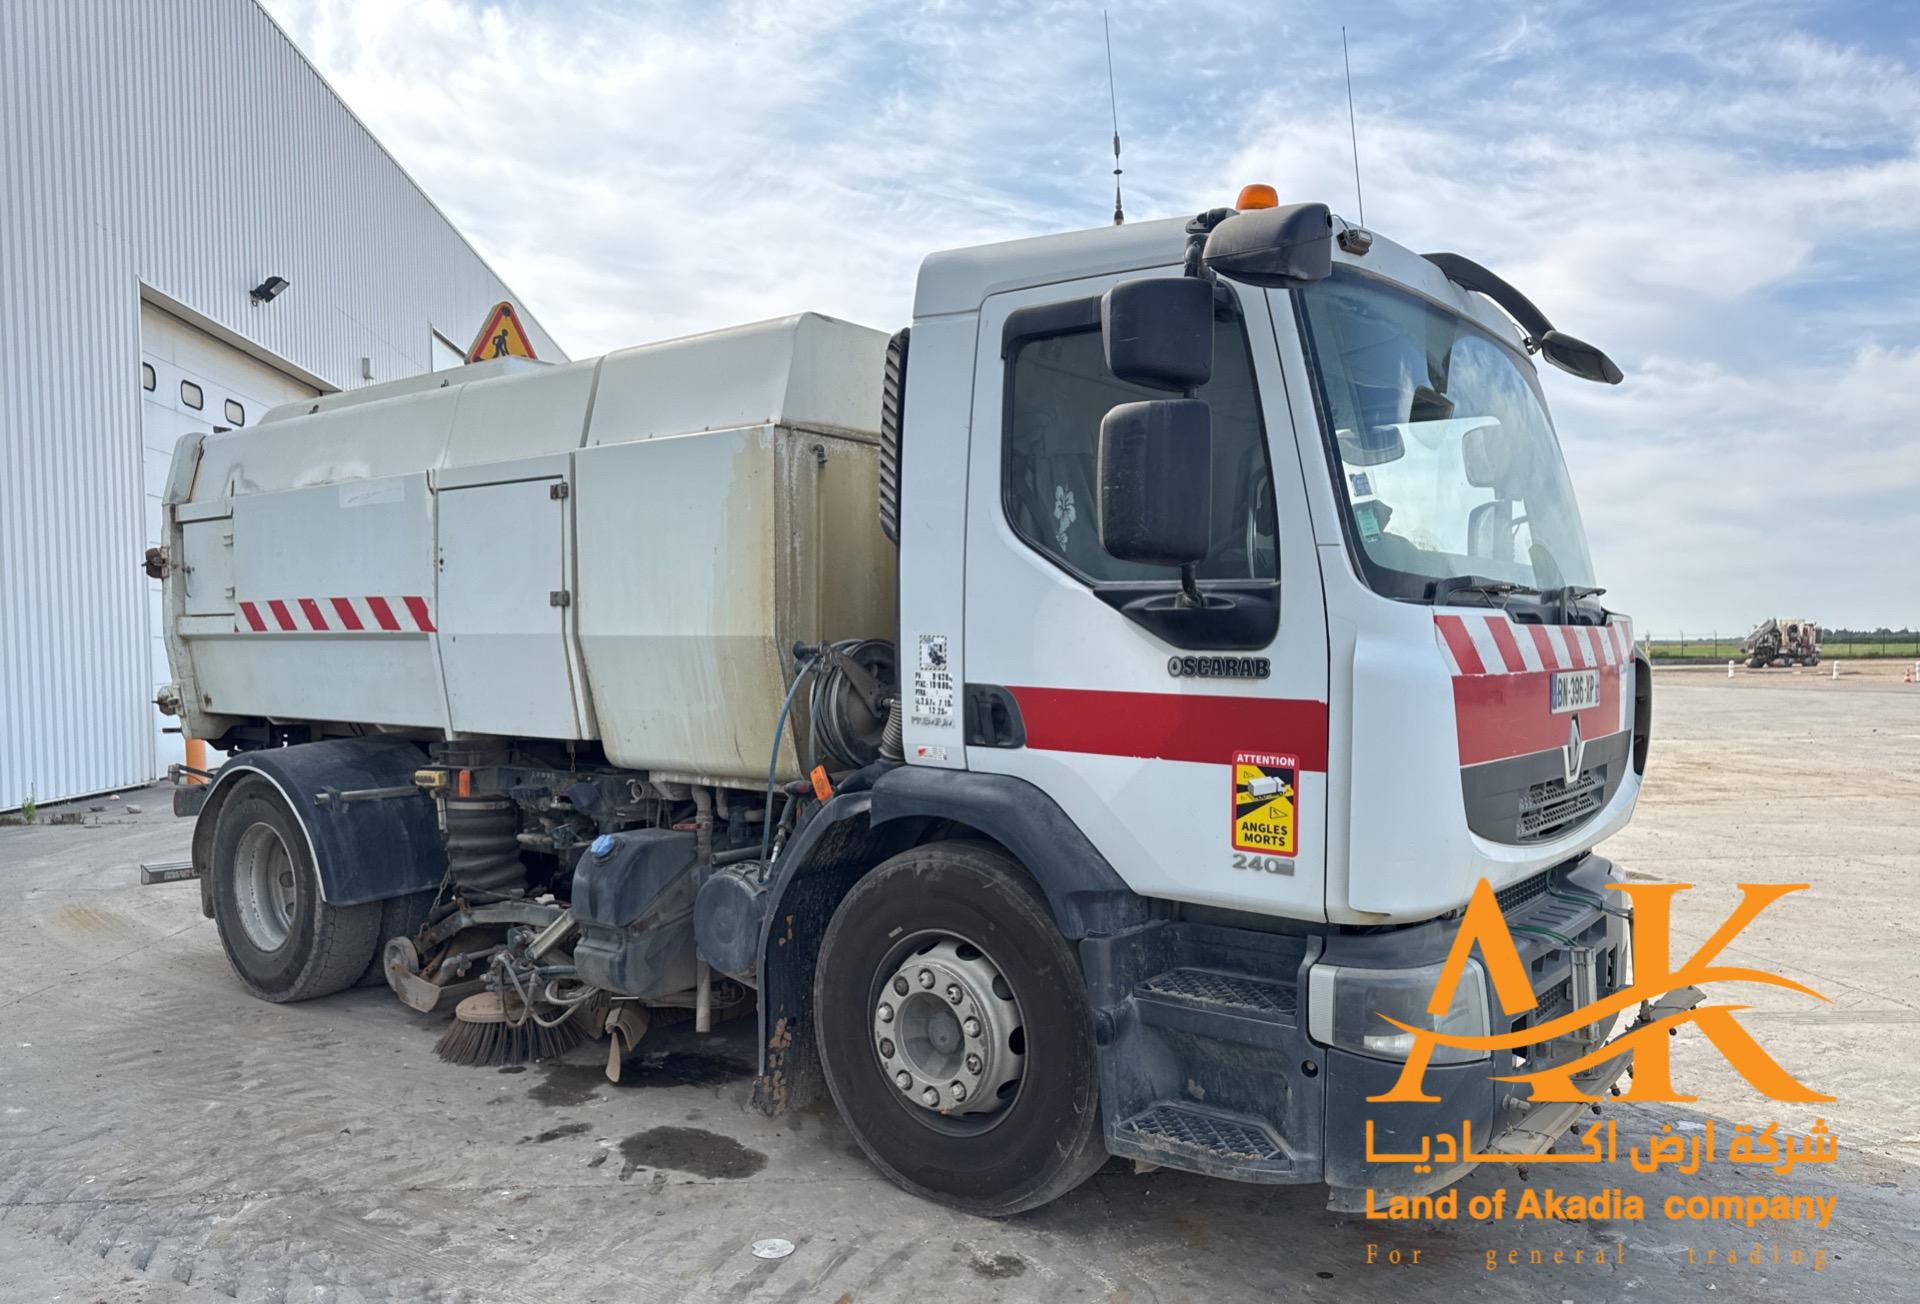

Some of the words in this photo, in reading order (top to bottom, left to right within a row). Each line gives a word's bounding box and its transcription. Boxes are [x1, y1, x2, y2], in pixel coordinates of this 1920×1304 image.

[1236, 753, 1295, 767] ATTENTION
[1241, 821, 1288, 836] ANGLES
[1243, 833, 1286, 847] MORTS
